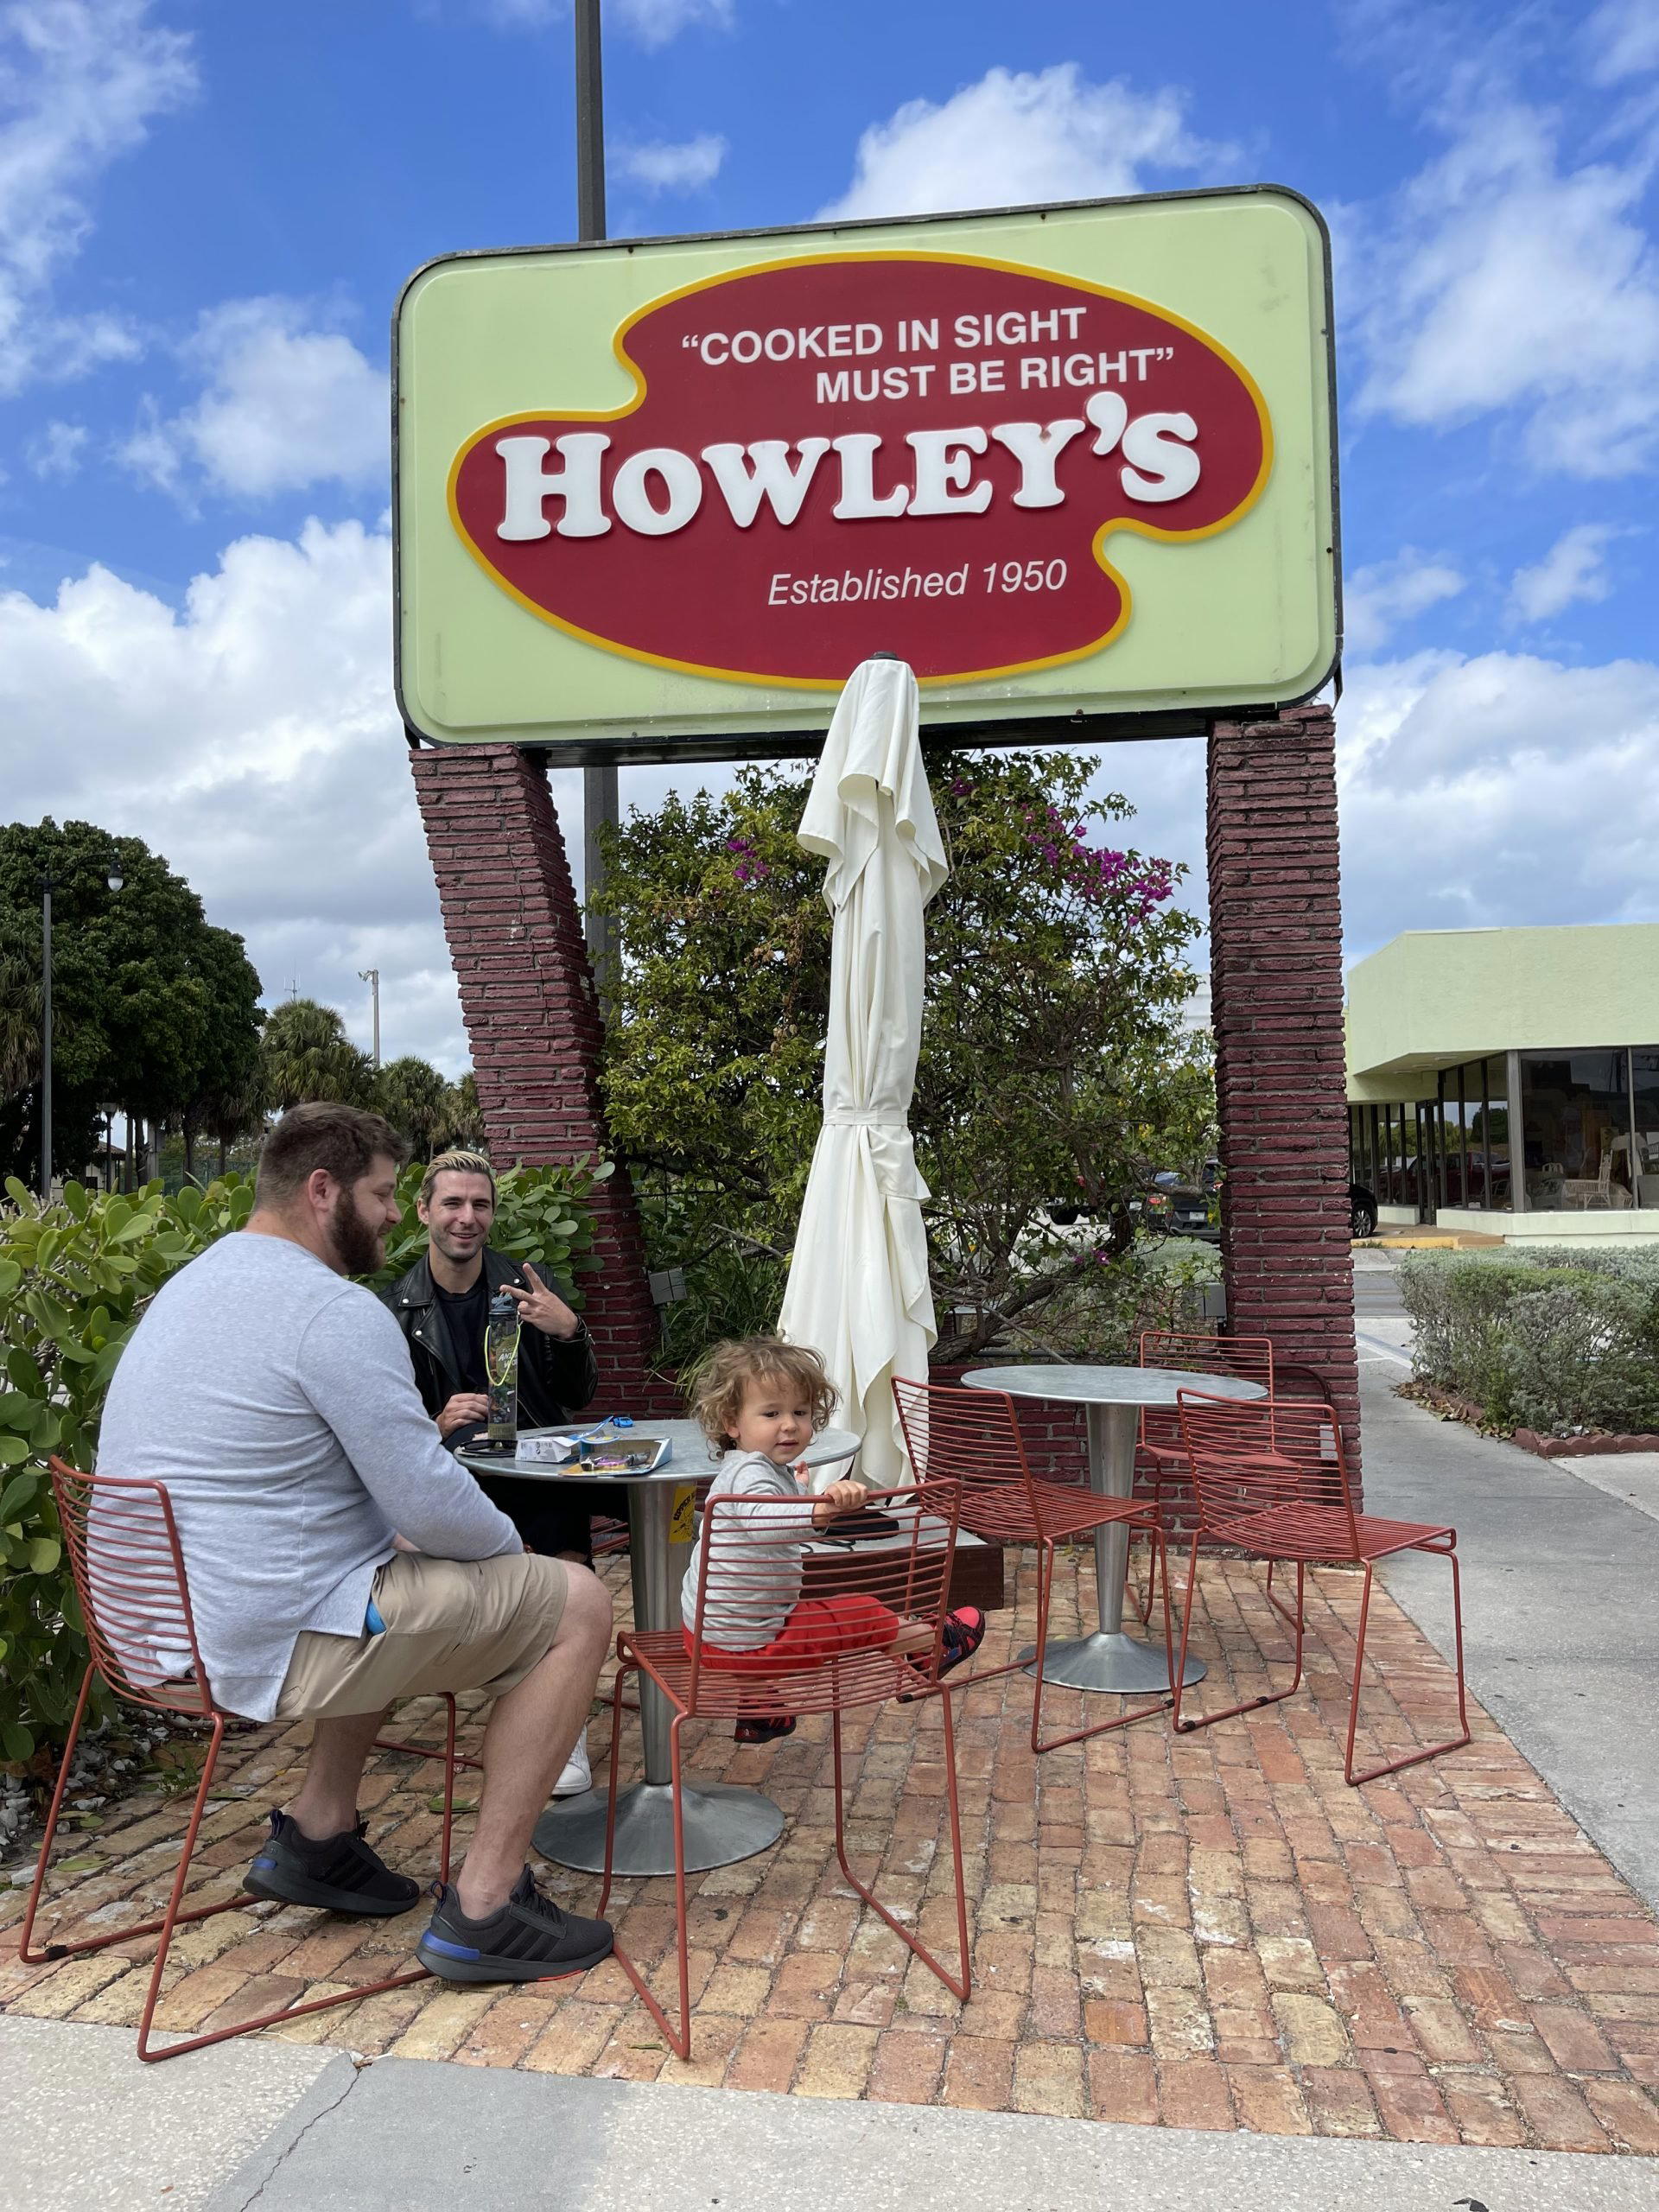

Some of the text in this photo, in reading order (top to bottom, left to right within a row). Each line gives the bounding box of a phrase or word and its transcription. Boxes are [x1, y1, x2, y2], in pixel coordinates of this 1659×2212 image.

[682, 307, 1087, 365] “COOKED IN SIGHT
[817, 346, 1174, 404] MUST BE RIGHT”
[495, 391, 1201, 541] HOWLEY’S
[767, 558, 1067, 606] Established 1950
